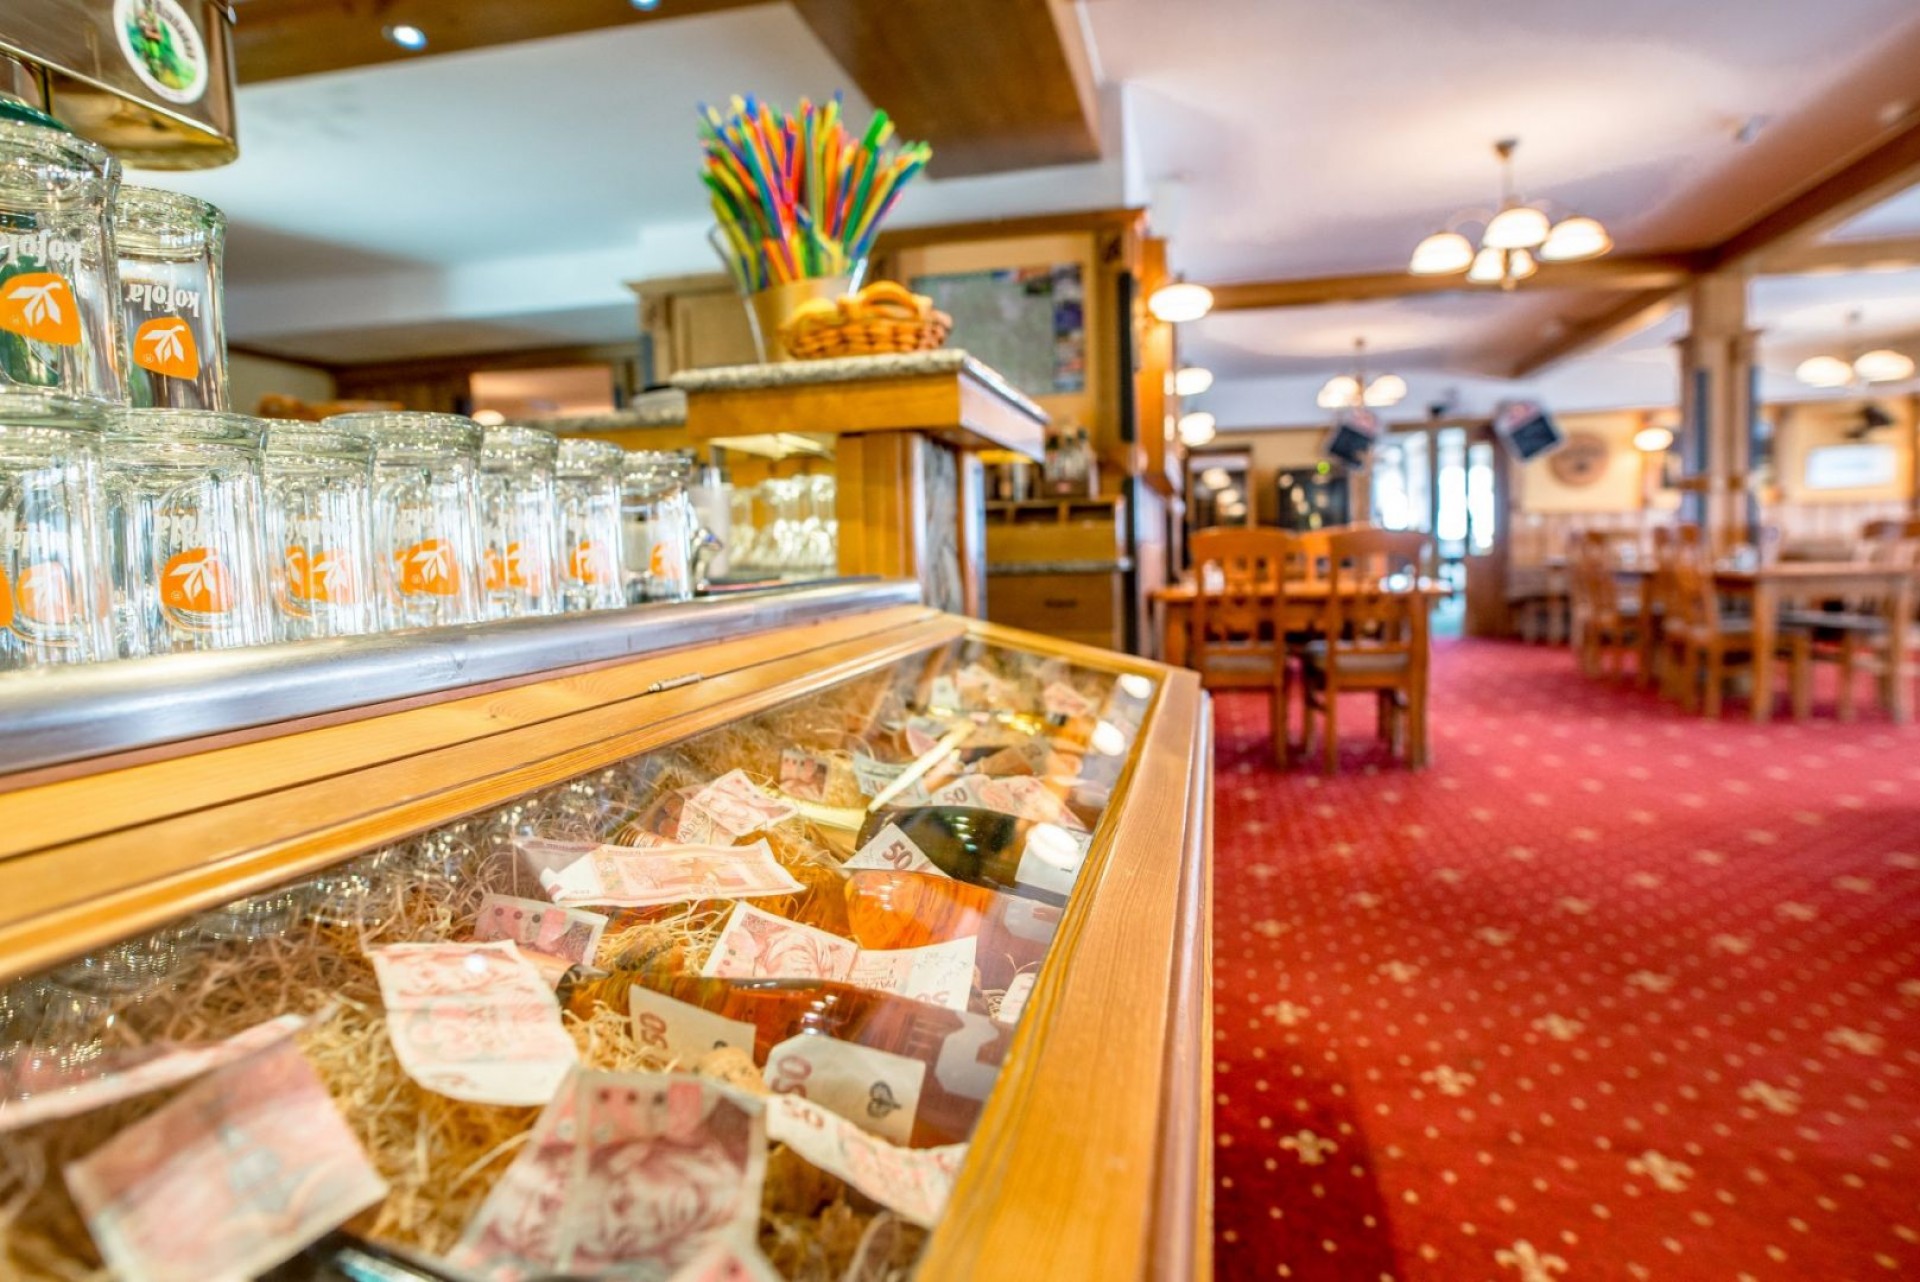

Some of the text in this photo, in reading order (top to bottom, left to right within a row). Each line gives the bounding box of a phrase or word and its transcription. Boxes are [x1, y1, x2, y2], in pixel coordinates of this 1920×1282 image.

[126, 280, 200, 317] kofola
[881, 839, 914, 871] 50
[638, 1011, 668, 1051] 50
[770, 1054, 813, 1098] 50
